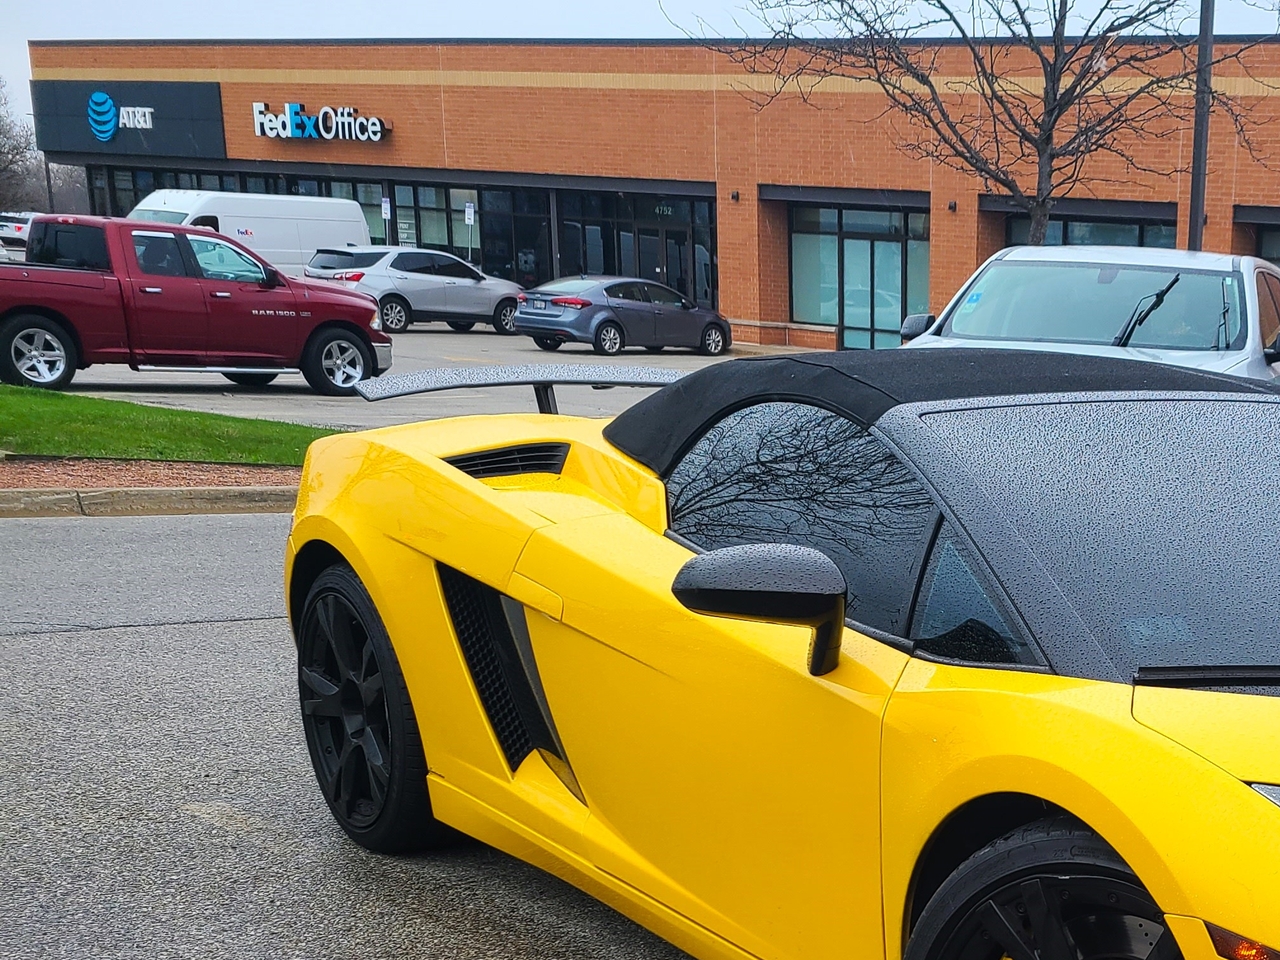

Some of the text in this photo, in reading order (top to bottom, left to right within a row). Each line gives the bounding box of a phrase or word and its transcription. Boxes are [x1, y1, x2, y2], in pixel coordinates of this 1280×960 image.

[119, 106, 154, 128] AT&T
[252, 102, 381, 141] FedEx Office
[654, 205, 673, 215] 4752
